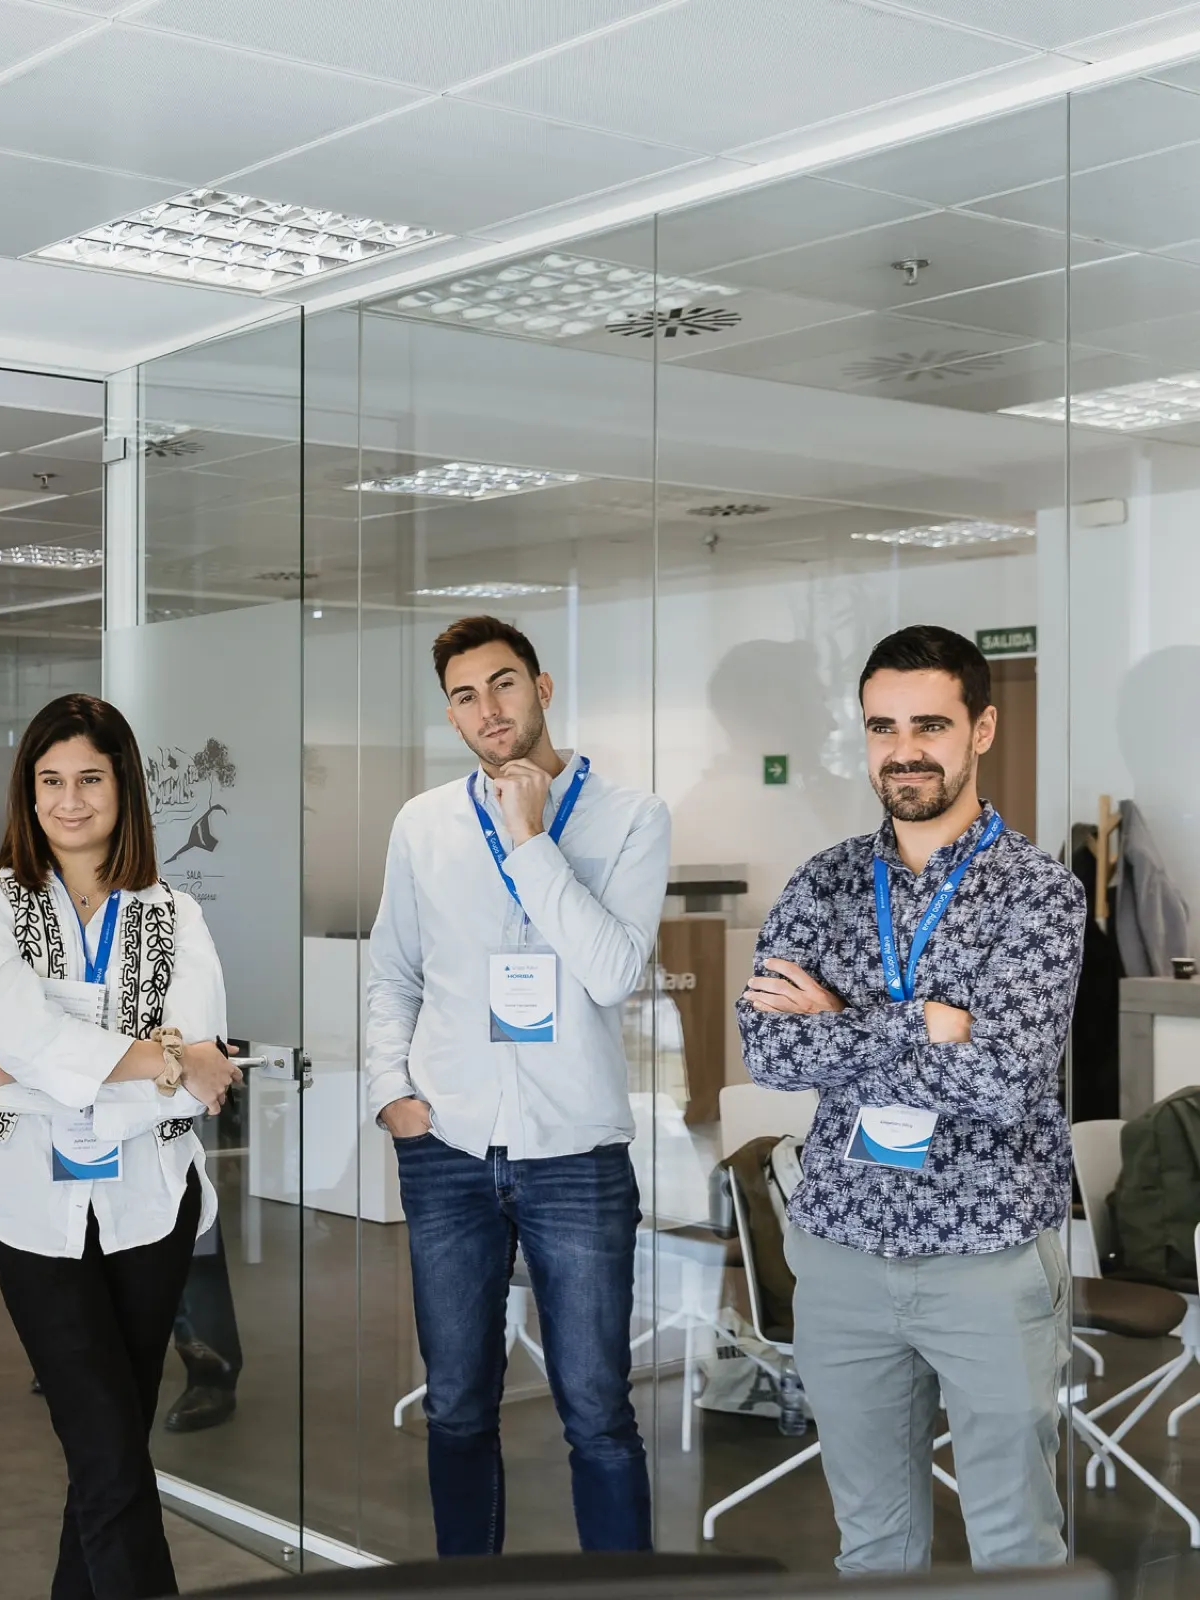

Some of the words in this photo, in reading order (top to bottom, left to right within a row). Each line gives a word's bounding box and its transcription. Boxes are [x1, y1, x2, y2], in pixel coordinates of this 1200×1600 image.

[981, 632, 1034, 651] SALIDA
[186, 870, 202, 880] SALA
[932, 893, 949, 914] Grupo
